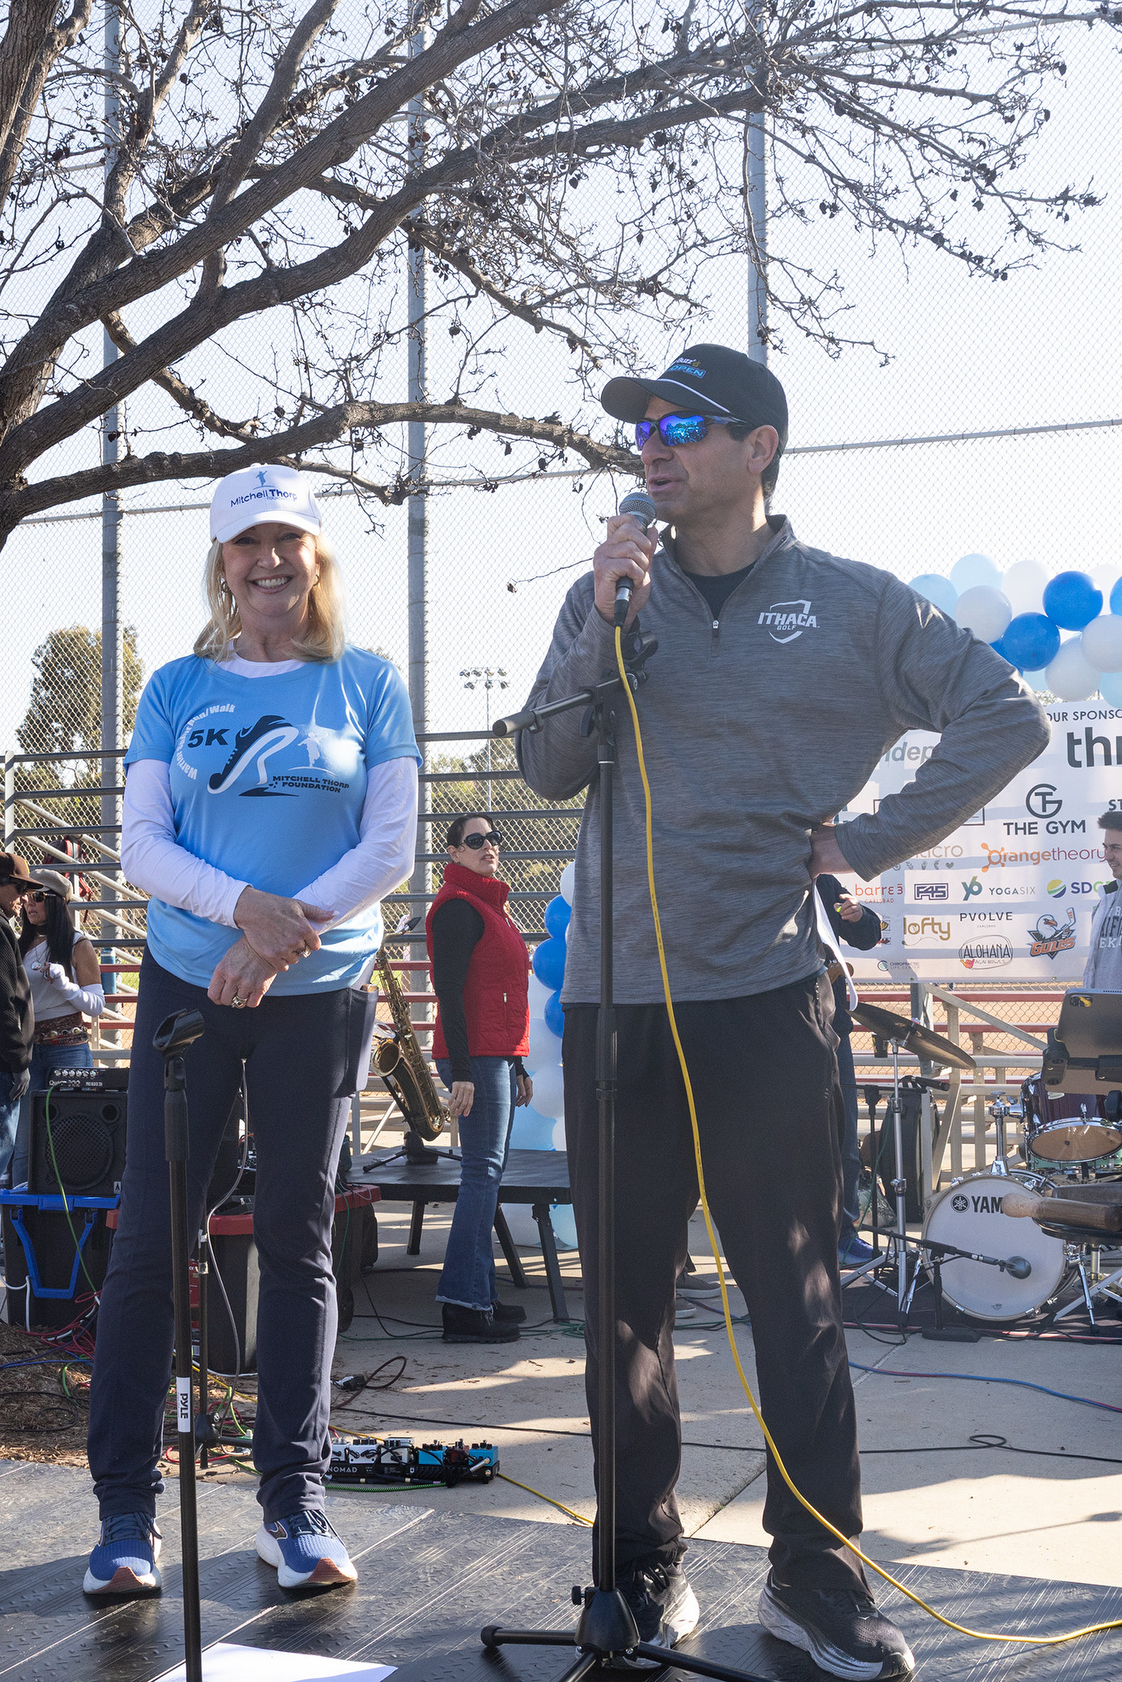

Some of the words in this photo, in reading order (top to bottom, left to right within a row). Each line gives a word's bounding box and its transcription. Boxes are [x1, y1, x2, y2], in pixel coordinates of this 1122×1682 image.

[230, 489, 268, 507] Mitchell
[758, 612, 817, 628] ITHACA
[187, 728, 231, 748] 5K
[272, 775, 321, 783] MITCHELL
[322, 778, 350, 789] THORP
[282, 781, 341, 793] FOUNDATION
[1003, 822, 1038, 836] THE
[1045, 820, 1086, 835] GYM
[916, 885, 946, 899] F45
[989, 886, 1036, 896] YOGASIX
[959, 911, 1013, 921] PVOLVE
[903, 917, 951, 941] lofty
[1030, 936, 1077, 956] GULLS
